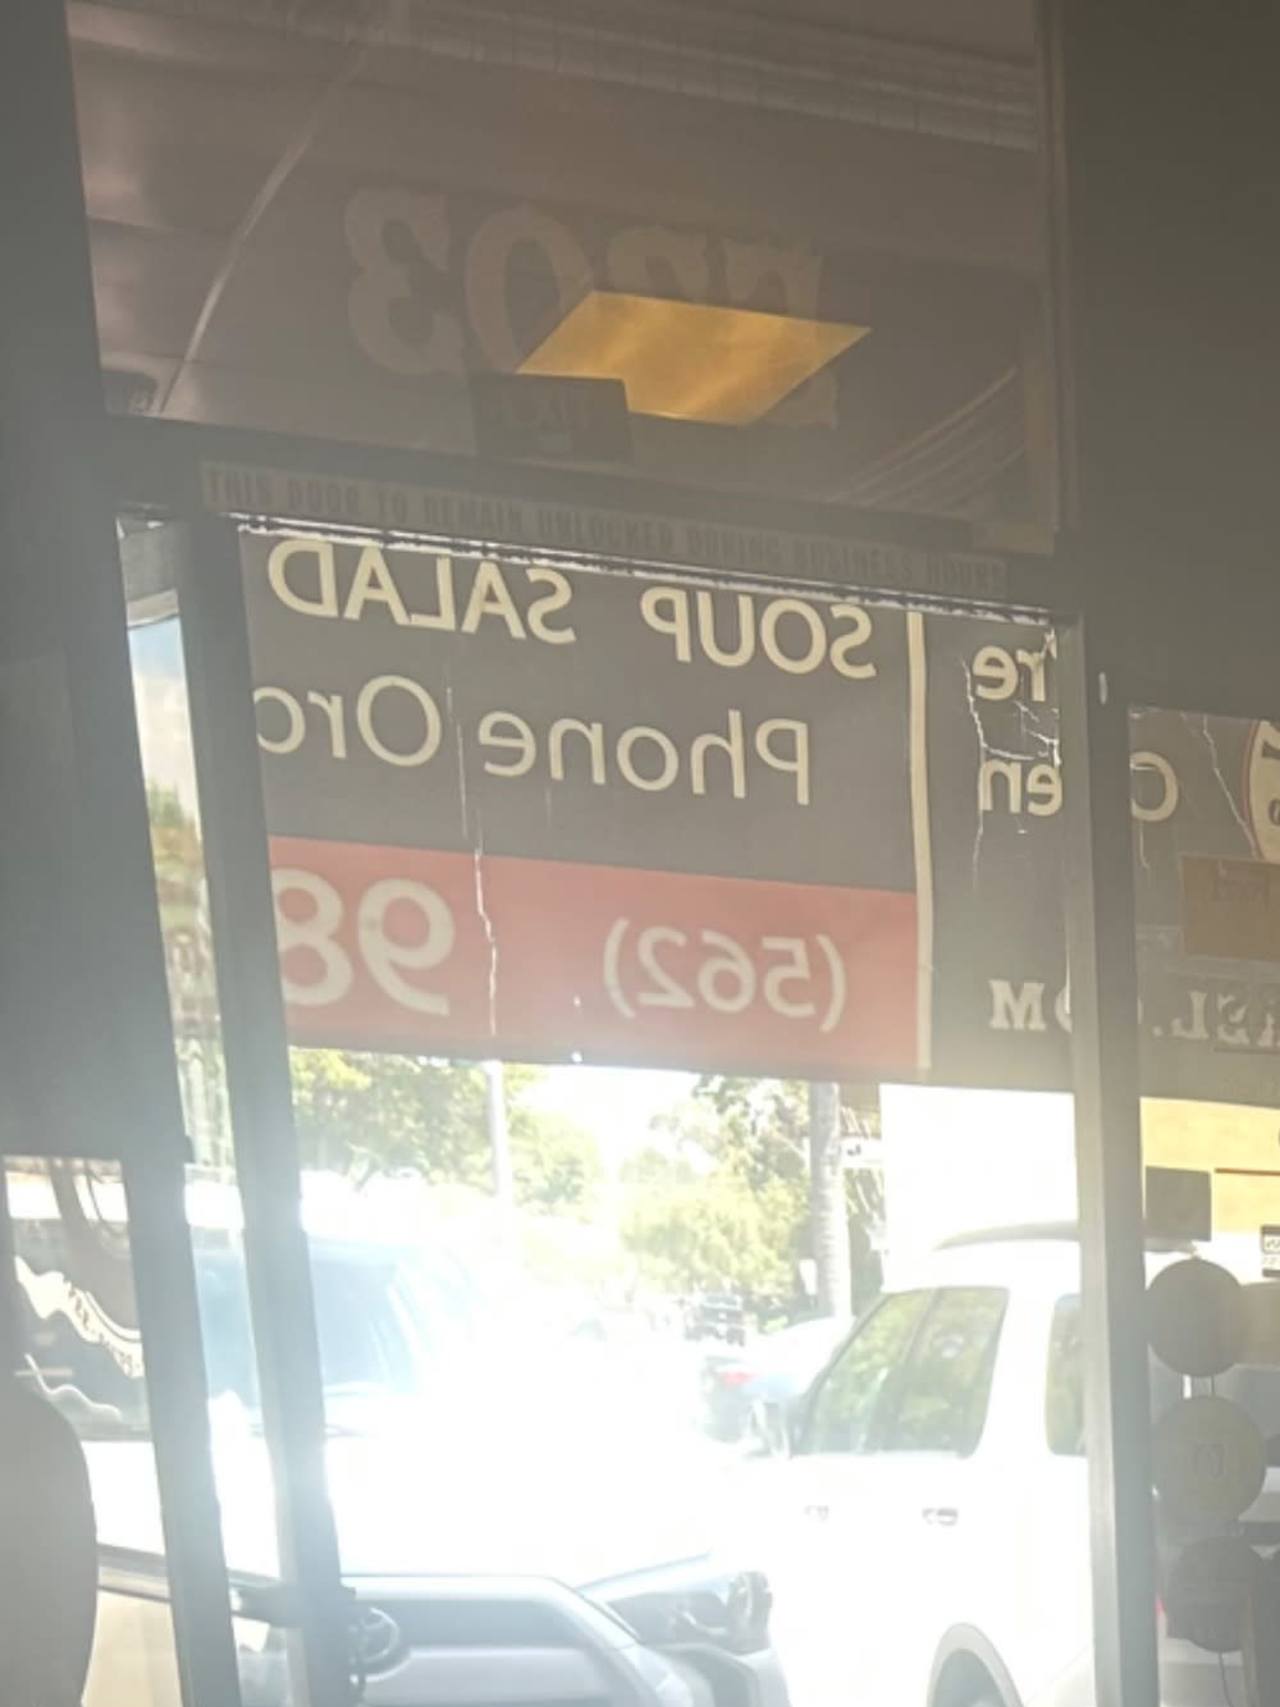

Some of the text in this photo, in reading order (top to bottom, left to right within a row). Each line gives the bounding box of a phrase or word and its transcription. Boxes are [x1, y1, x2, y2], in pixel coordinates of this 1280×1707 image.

[208, 469, 271, 507] THIS
[287, 482, 359, 518] DOOR
[377, 490, 408, 522] TO
[423, 495, 522, 533] REMAIN
